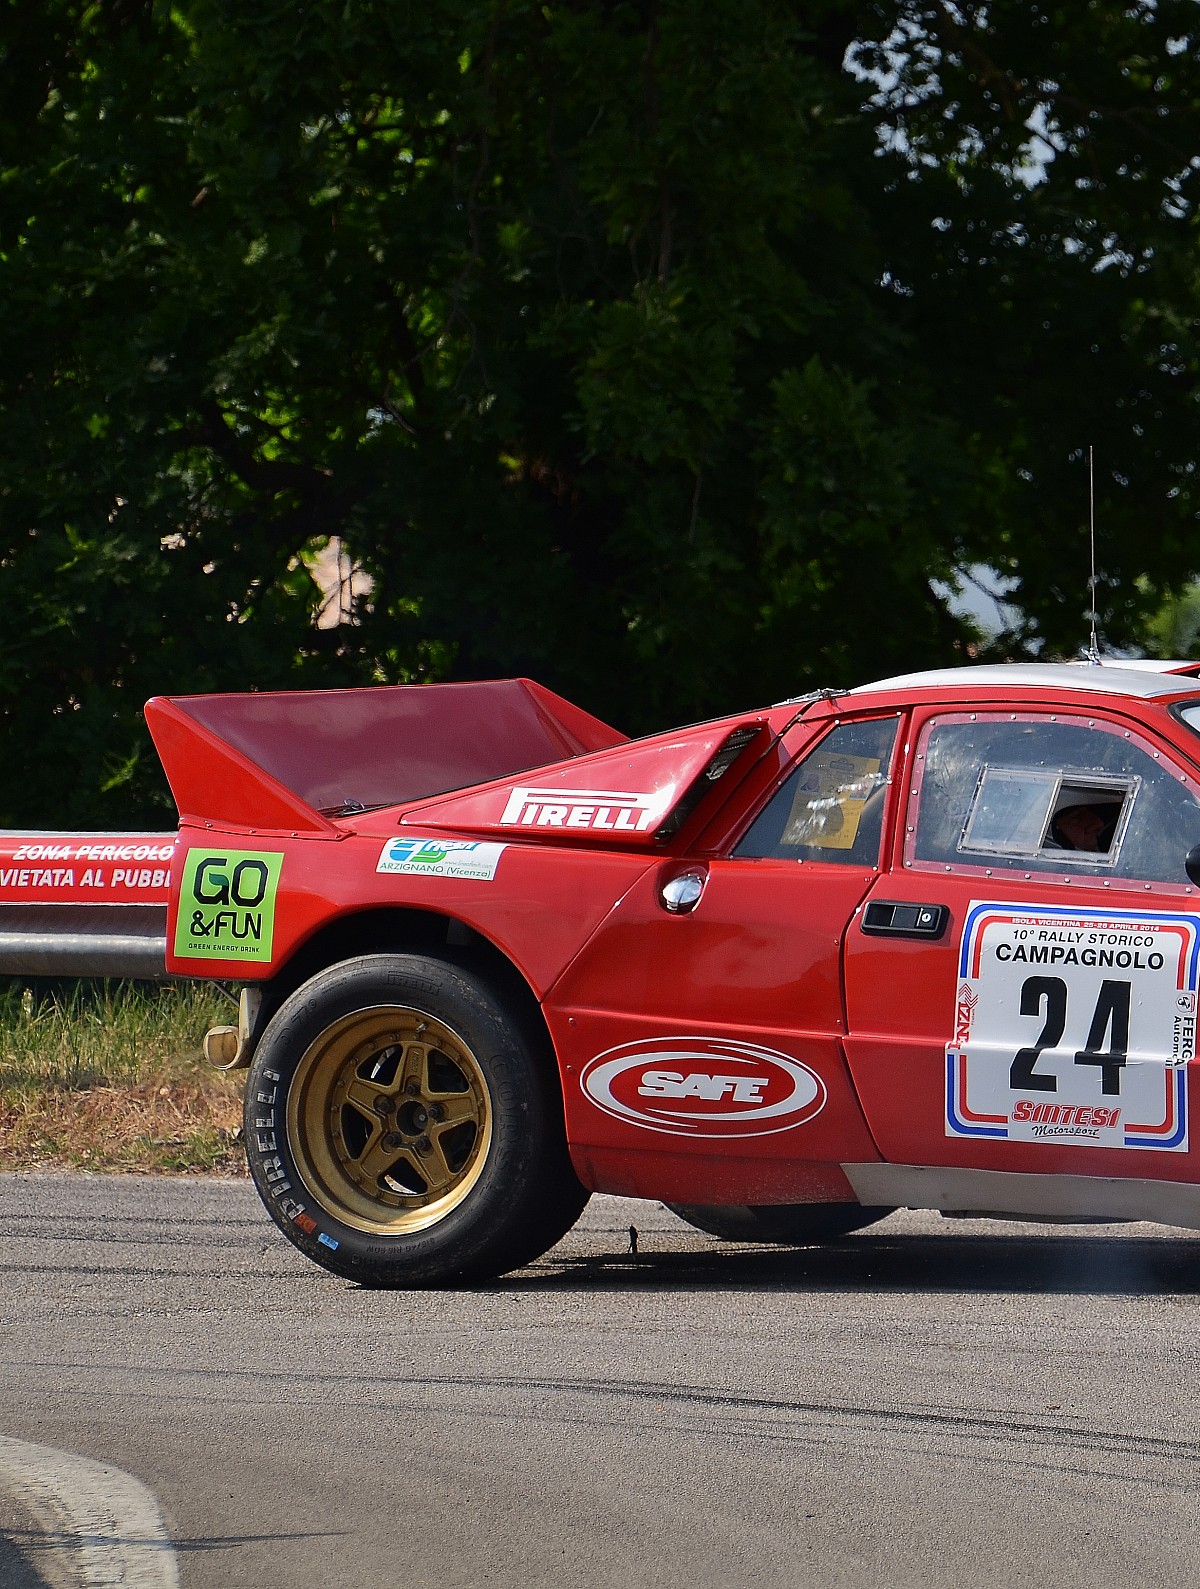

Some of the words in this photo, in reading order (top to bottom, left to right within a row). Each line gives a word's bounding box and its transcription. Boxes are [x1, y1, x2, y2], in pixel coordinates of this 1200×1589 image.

[500, 787, 669, 831] PIRELLI
[12, 844, 71, 861] ZONA
[0, 868, 74, 887] VIETATA
[79, 869, 104, 887] AL
[193, 857, 269, 908] GO
[379, 862, 444, 873] ARZIGNANO
[446, 867, 491, 878] (Vicenza)
[190, 910, 262, 940] &FUN
[1012, 917, 1036, 925] ISOLA
[1038, 919, 1080, 928] VICENTINA
[1108, 923, 1138, 931] APRILE
[213, 944, 239, 952] ENERGY
[1038, 930, 1084, 943] RALLY
[1088, 933, 1154, 947] STORICO
[995, 943, 1164, 970] CAMPAGNOLO
[1010, 976, 1131, 1095] 24
[637, 1070, 769, 1103] SAFE
[1012, 1100, 1122, 1129] SINTESI
[255, 1068, 306, 1220] PIRELLI
[1032, 1125, 1100, 1137] Motorsport
